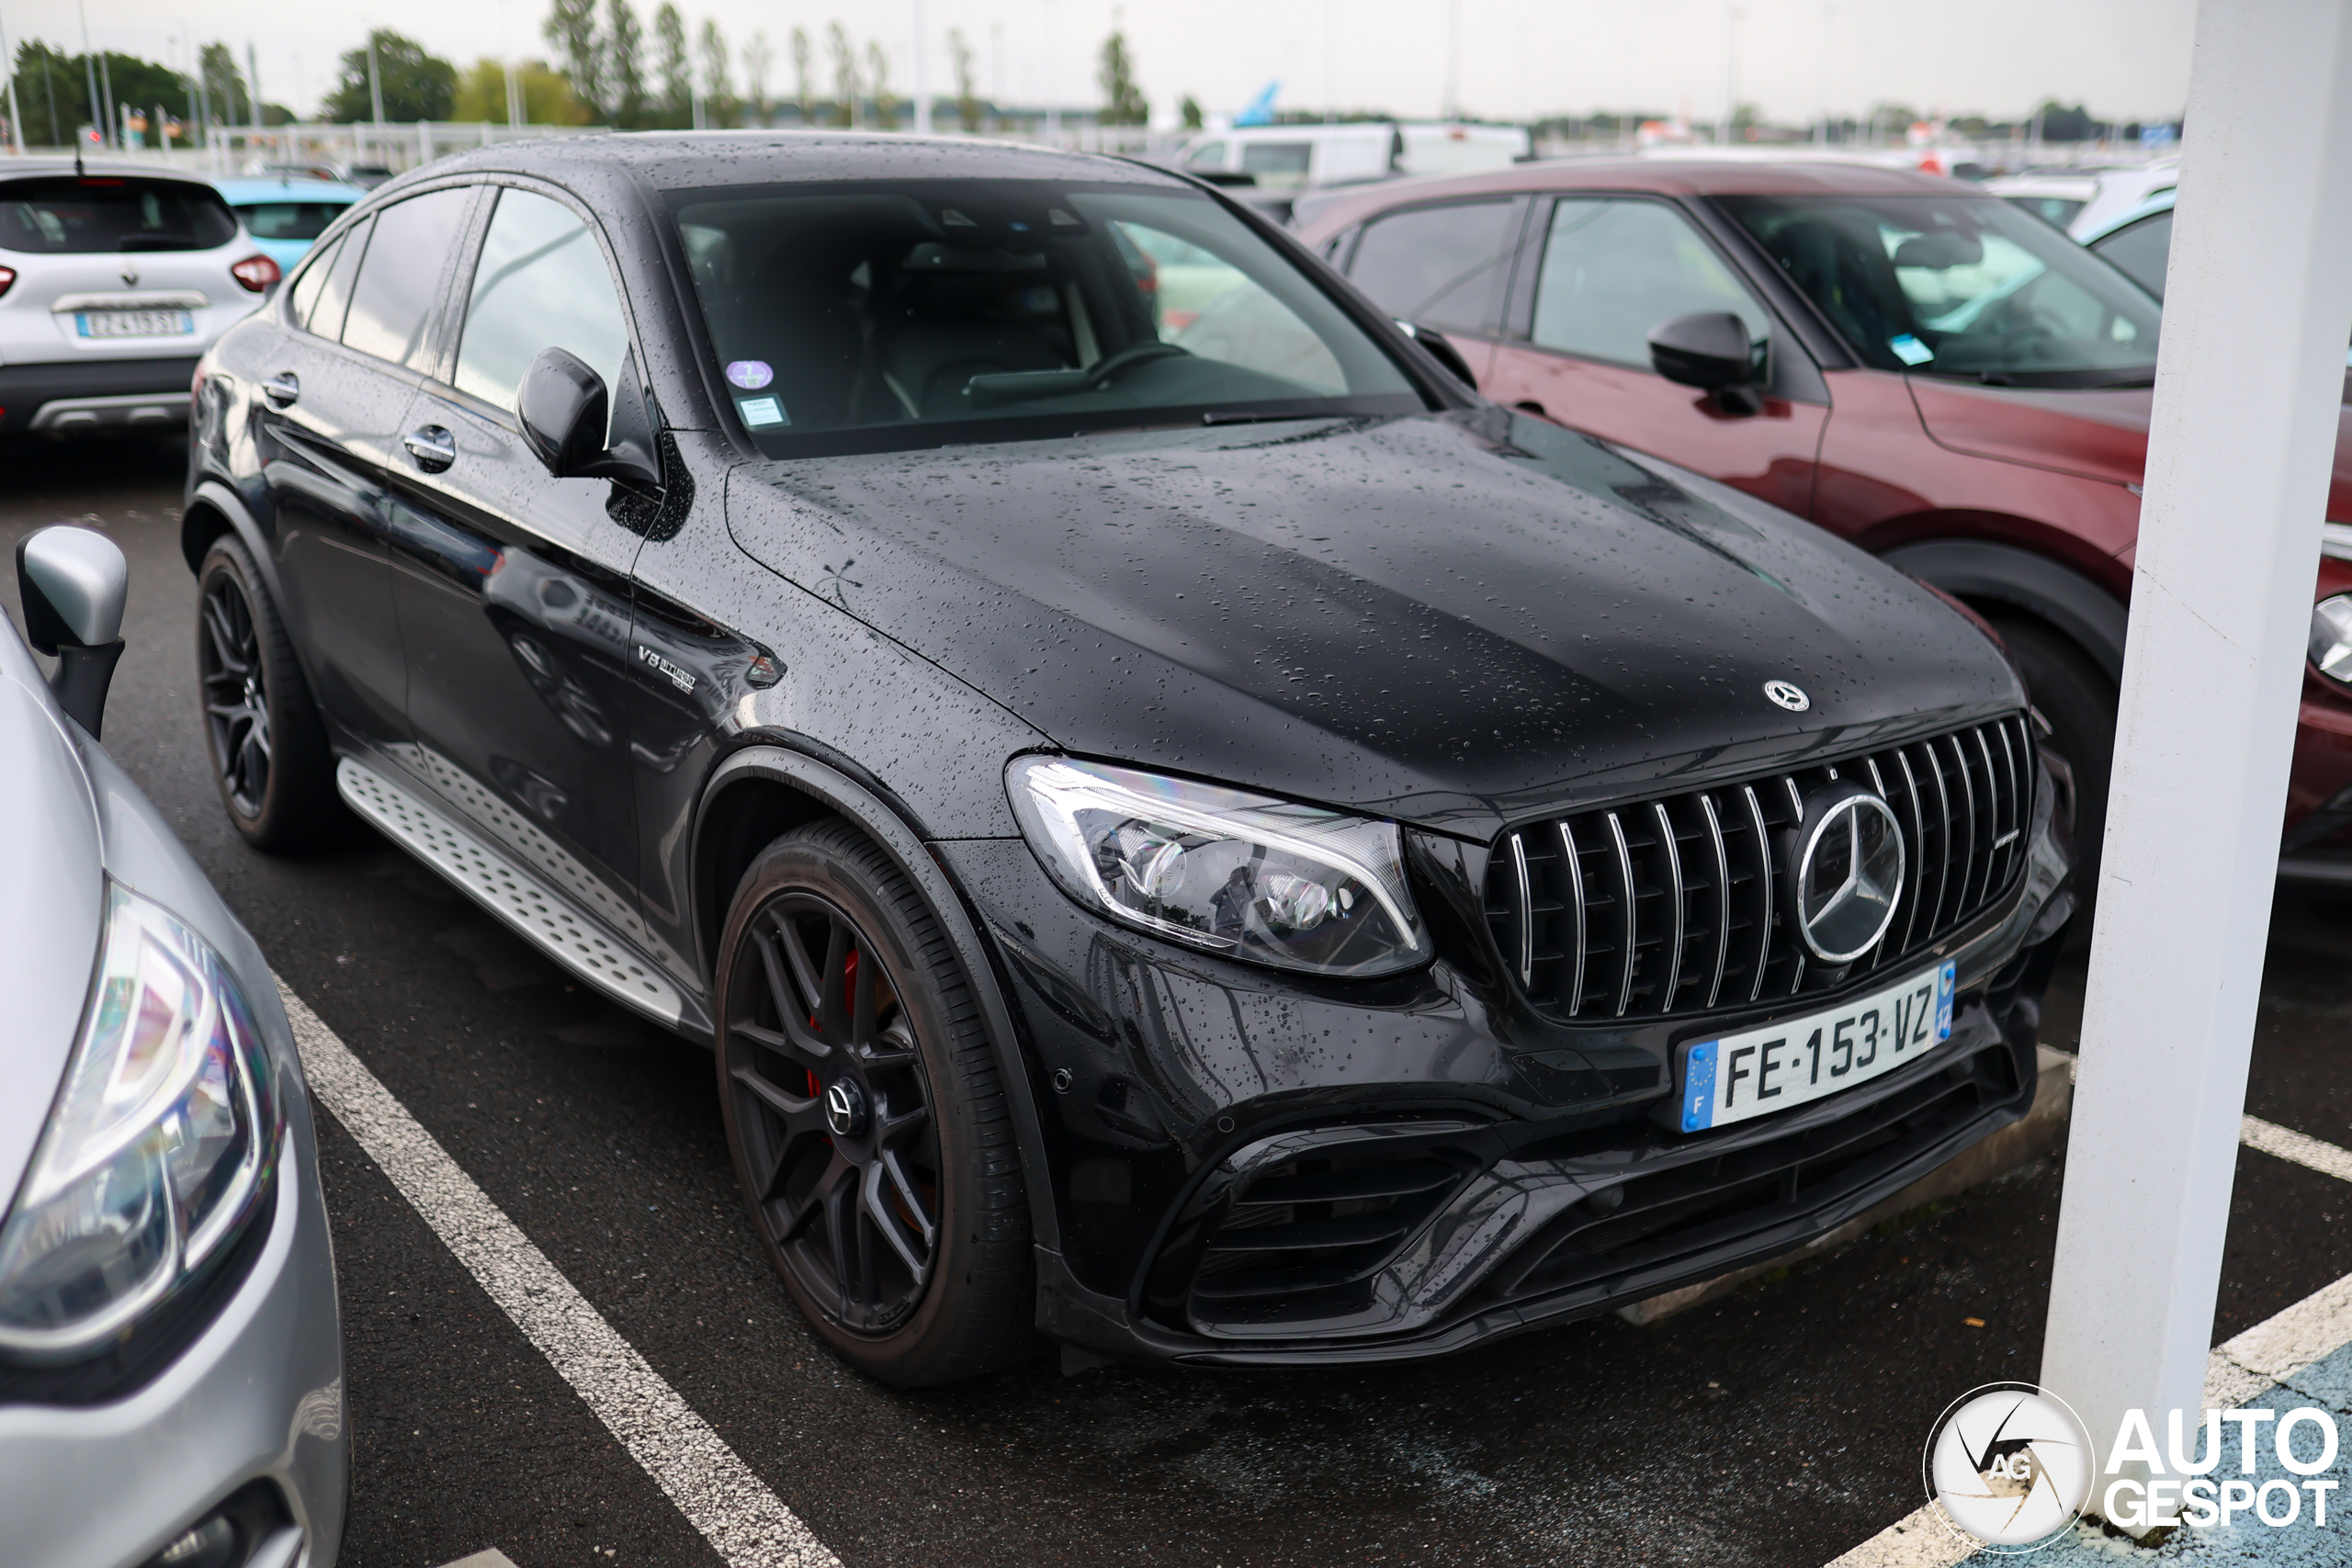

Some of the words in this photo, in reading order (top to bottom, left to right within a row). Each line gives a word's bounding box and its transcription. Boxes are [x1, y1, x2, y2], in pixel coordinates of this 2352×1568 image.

[638, 645, 661, 669] V8
[660, 658, 697, 687] BITURBO
[1692, 1096, 1705, 1114] F
[1724, 985, 1932, 1109] FE-153-VZ
